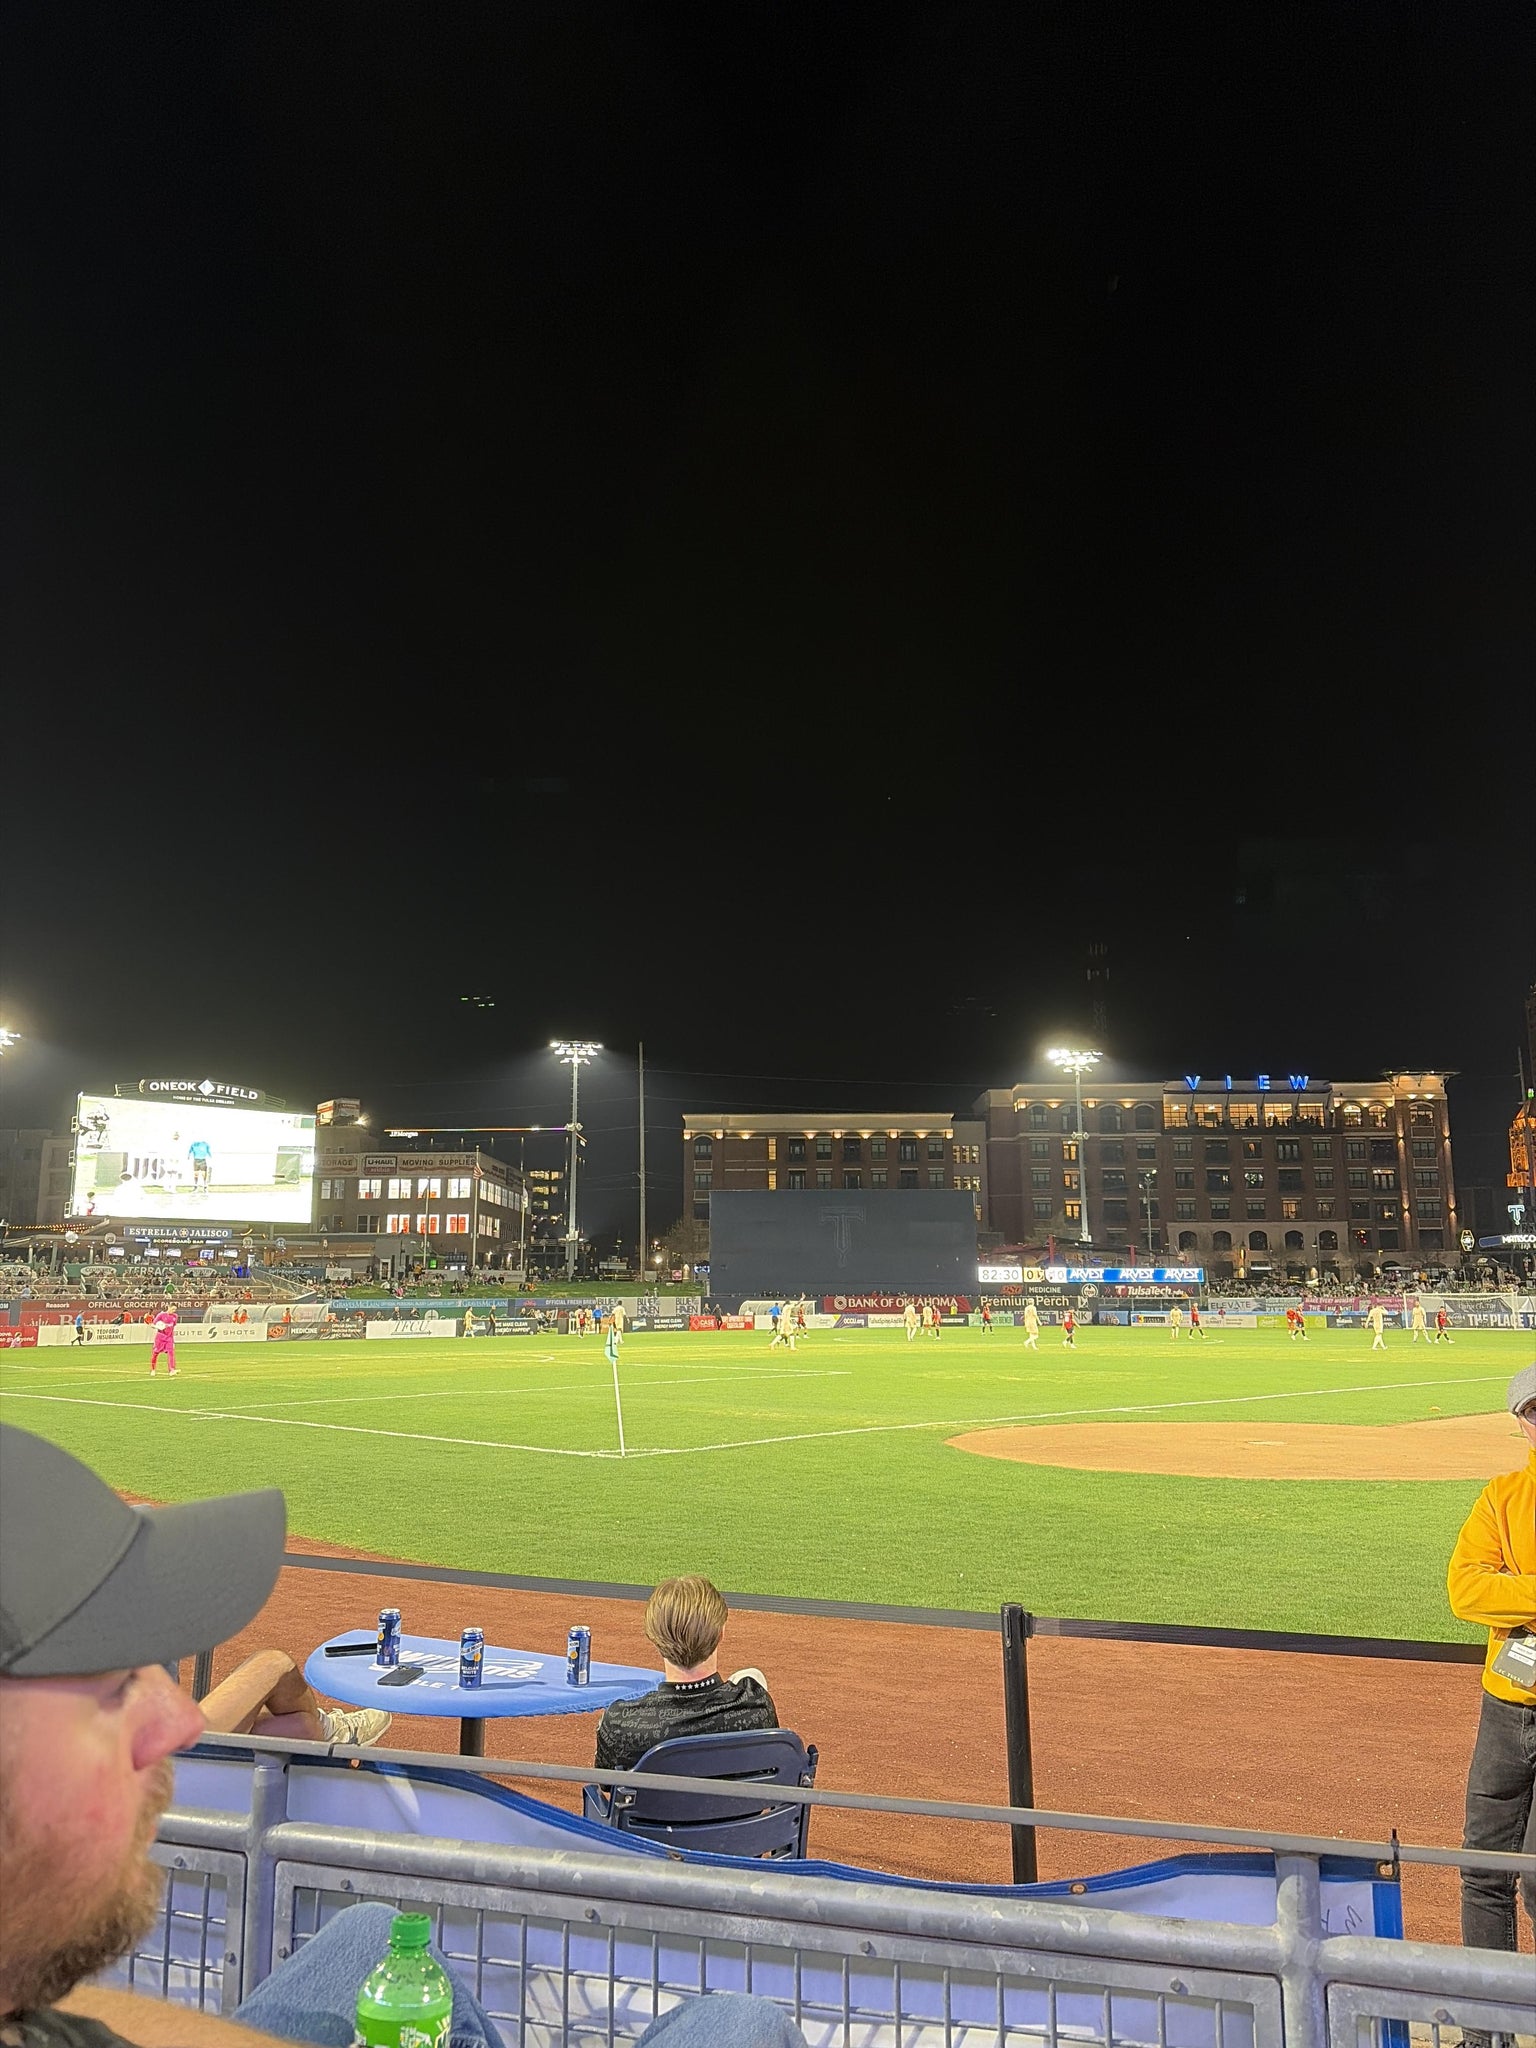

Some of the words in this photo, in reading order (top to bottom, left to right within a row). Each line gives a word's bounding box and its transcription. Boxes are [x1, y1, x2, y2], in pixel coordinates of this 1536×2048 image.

[1186, 1075, 1309, 1090] VIEW
[149, 1081, 197, 1091] ONEOK
[216, 1085, 258, 1100] FIELD
[319, 1159, 353, 1167] TORAGE
[438, 1158, 476, 1166] SUPPLIES
[129, 1227, 178, 1236] ESTRELLA
[190, 1229, 229, 1238] JALISCO
[982, 1269, 1019, 1280] 82:30
[1026, 1270, 1034, 1280] 0
[1070, 1269, 1104, 1281] ARVEST
[1119, 1269, 1155, 1281] ARVEST
[1164, 1269, 1199, 1281] ARVEST
[1028, 1286, 1061, 1294] MEDICINE
[123, 1301, 158, 1309] GROCERY
[848, 1300, 878, 1308] BANK
[880, 1299, 894, 1307] OF
[896, 1298, 958, 1308] OKLAHOMA
[1041, 1296, 1069, 1307] Perch
[1210, 1301, 1251, 1310] ELEVATE
[1058, 1311, 1088, 1320] BNK
[1490, 1313, 1524, 1328] PLACE
[222, 1328, 256, 1336] SHOTS
